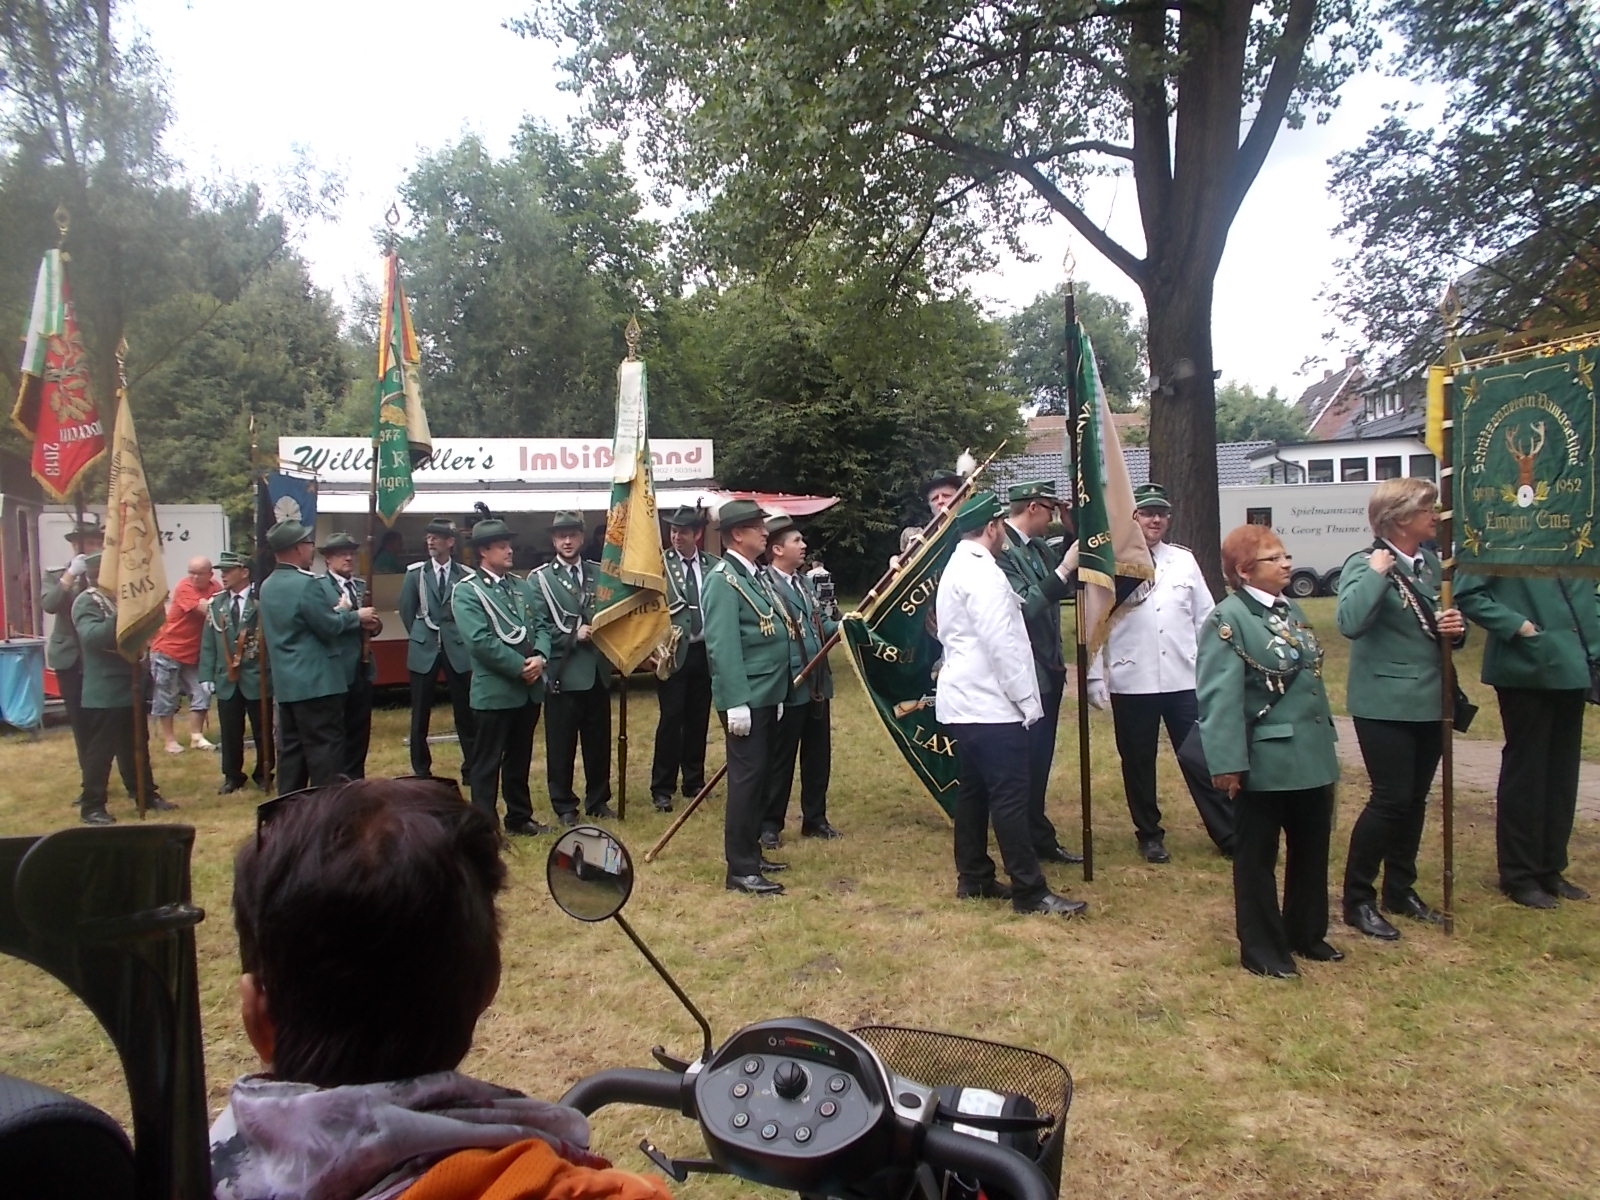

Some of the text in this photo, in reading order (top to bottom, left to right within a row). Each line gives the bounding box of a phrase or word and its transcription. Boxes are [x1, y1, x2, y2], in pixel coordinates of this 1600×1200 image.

[519, 444, 702, 471] Imbißand
[1556, 478, 1582, 493] 1952
[1290, 506, 1365, 518] Spielmannszug
[1291, 525, 1322, 536] Georg
[121, 576, 155, 600] EMS
[912, 724, 958, 756] LAX
